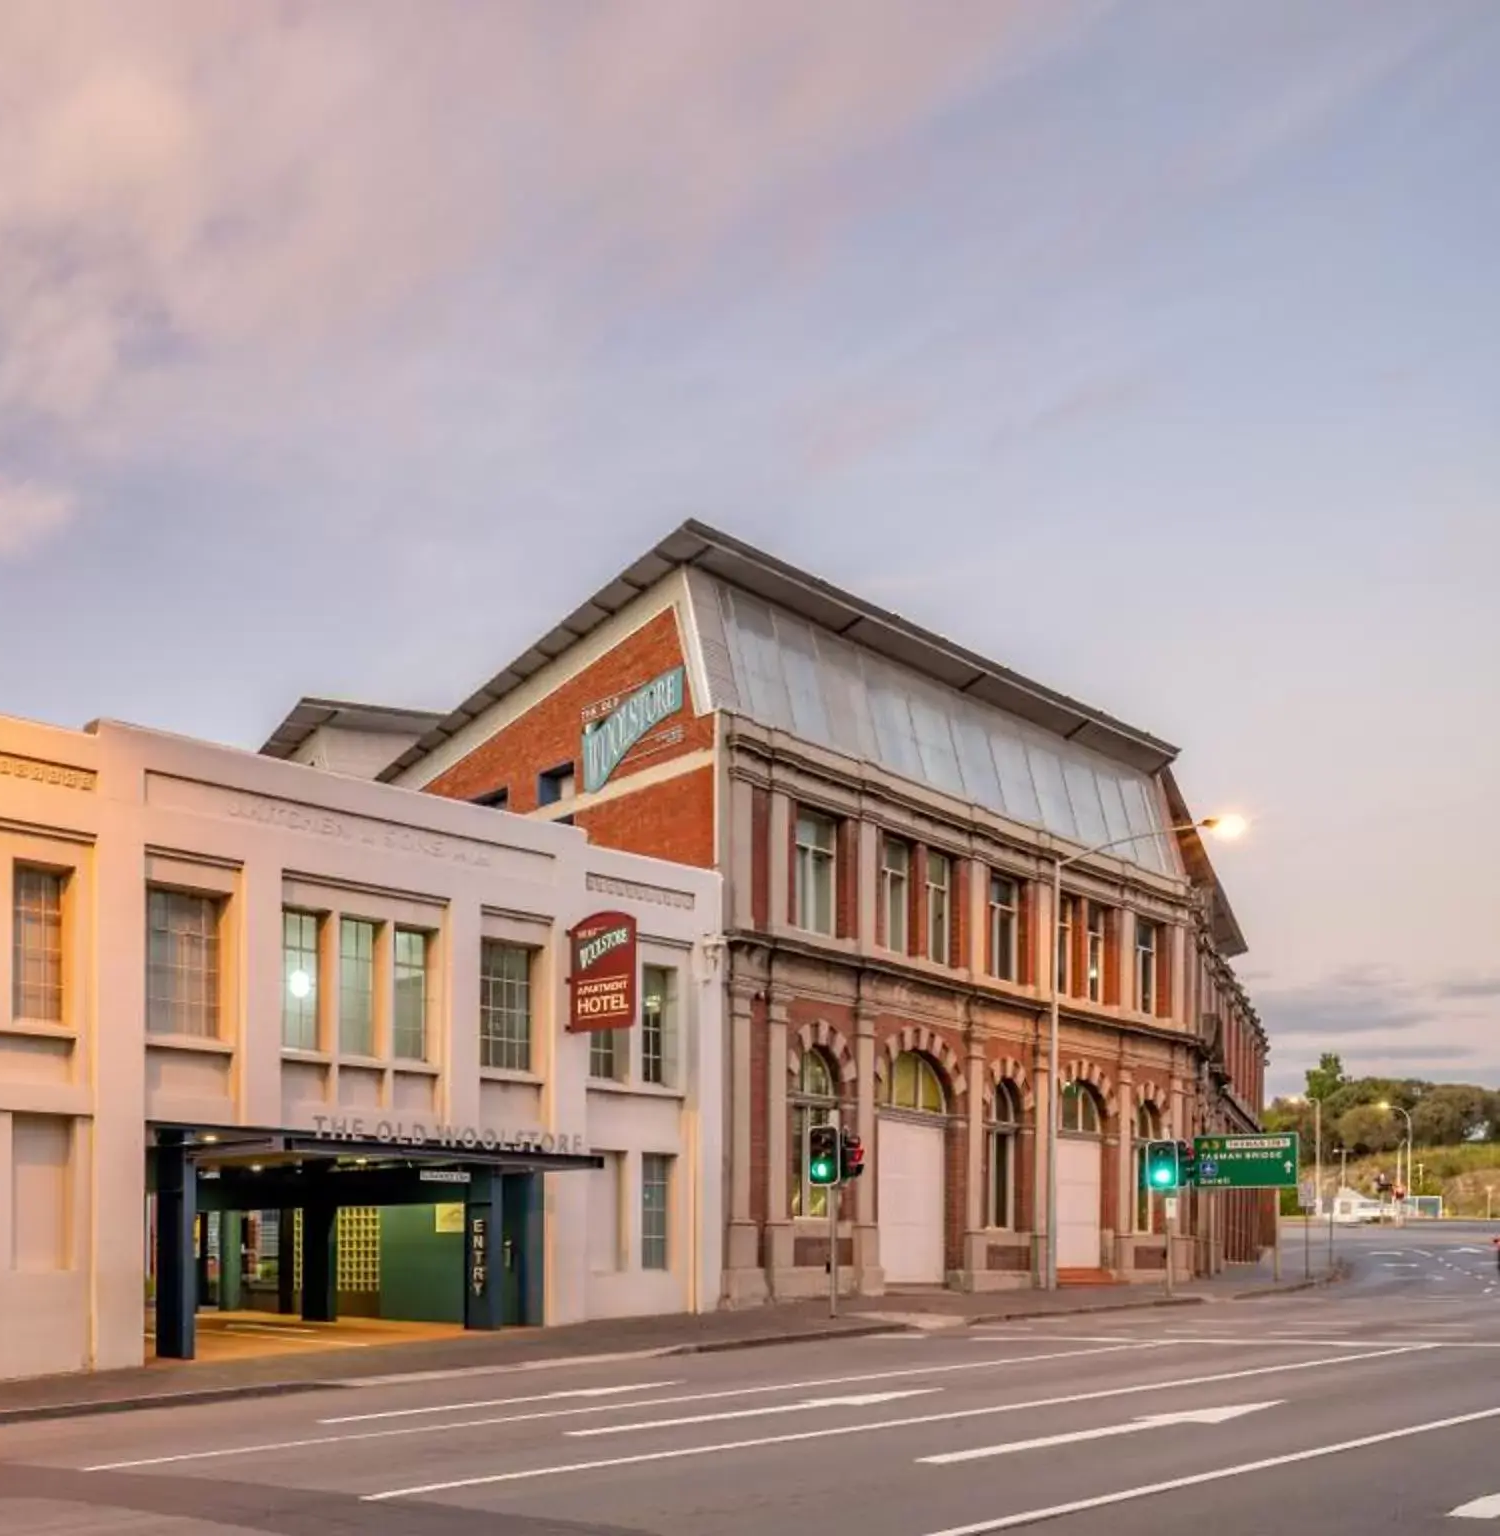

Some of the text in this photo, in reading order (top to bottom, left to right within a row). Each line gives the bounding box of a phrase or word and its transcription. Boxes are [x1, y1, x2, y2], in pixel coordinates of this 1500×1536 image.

[577, 980, 628, 995] APARTMENT
[577, 993, 629, 1015] HOTEL
[312, 1115, 583, 1154] THE OLD WOOLSTORE
[1200, 1150, 1283, 1161] TASMAN BRIDGE
[471, 1219, 486, 1297] ENTRY
